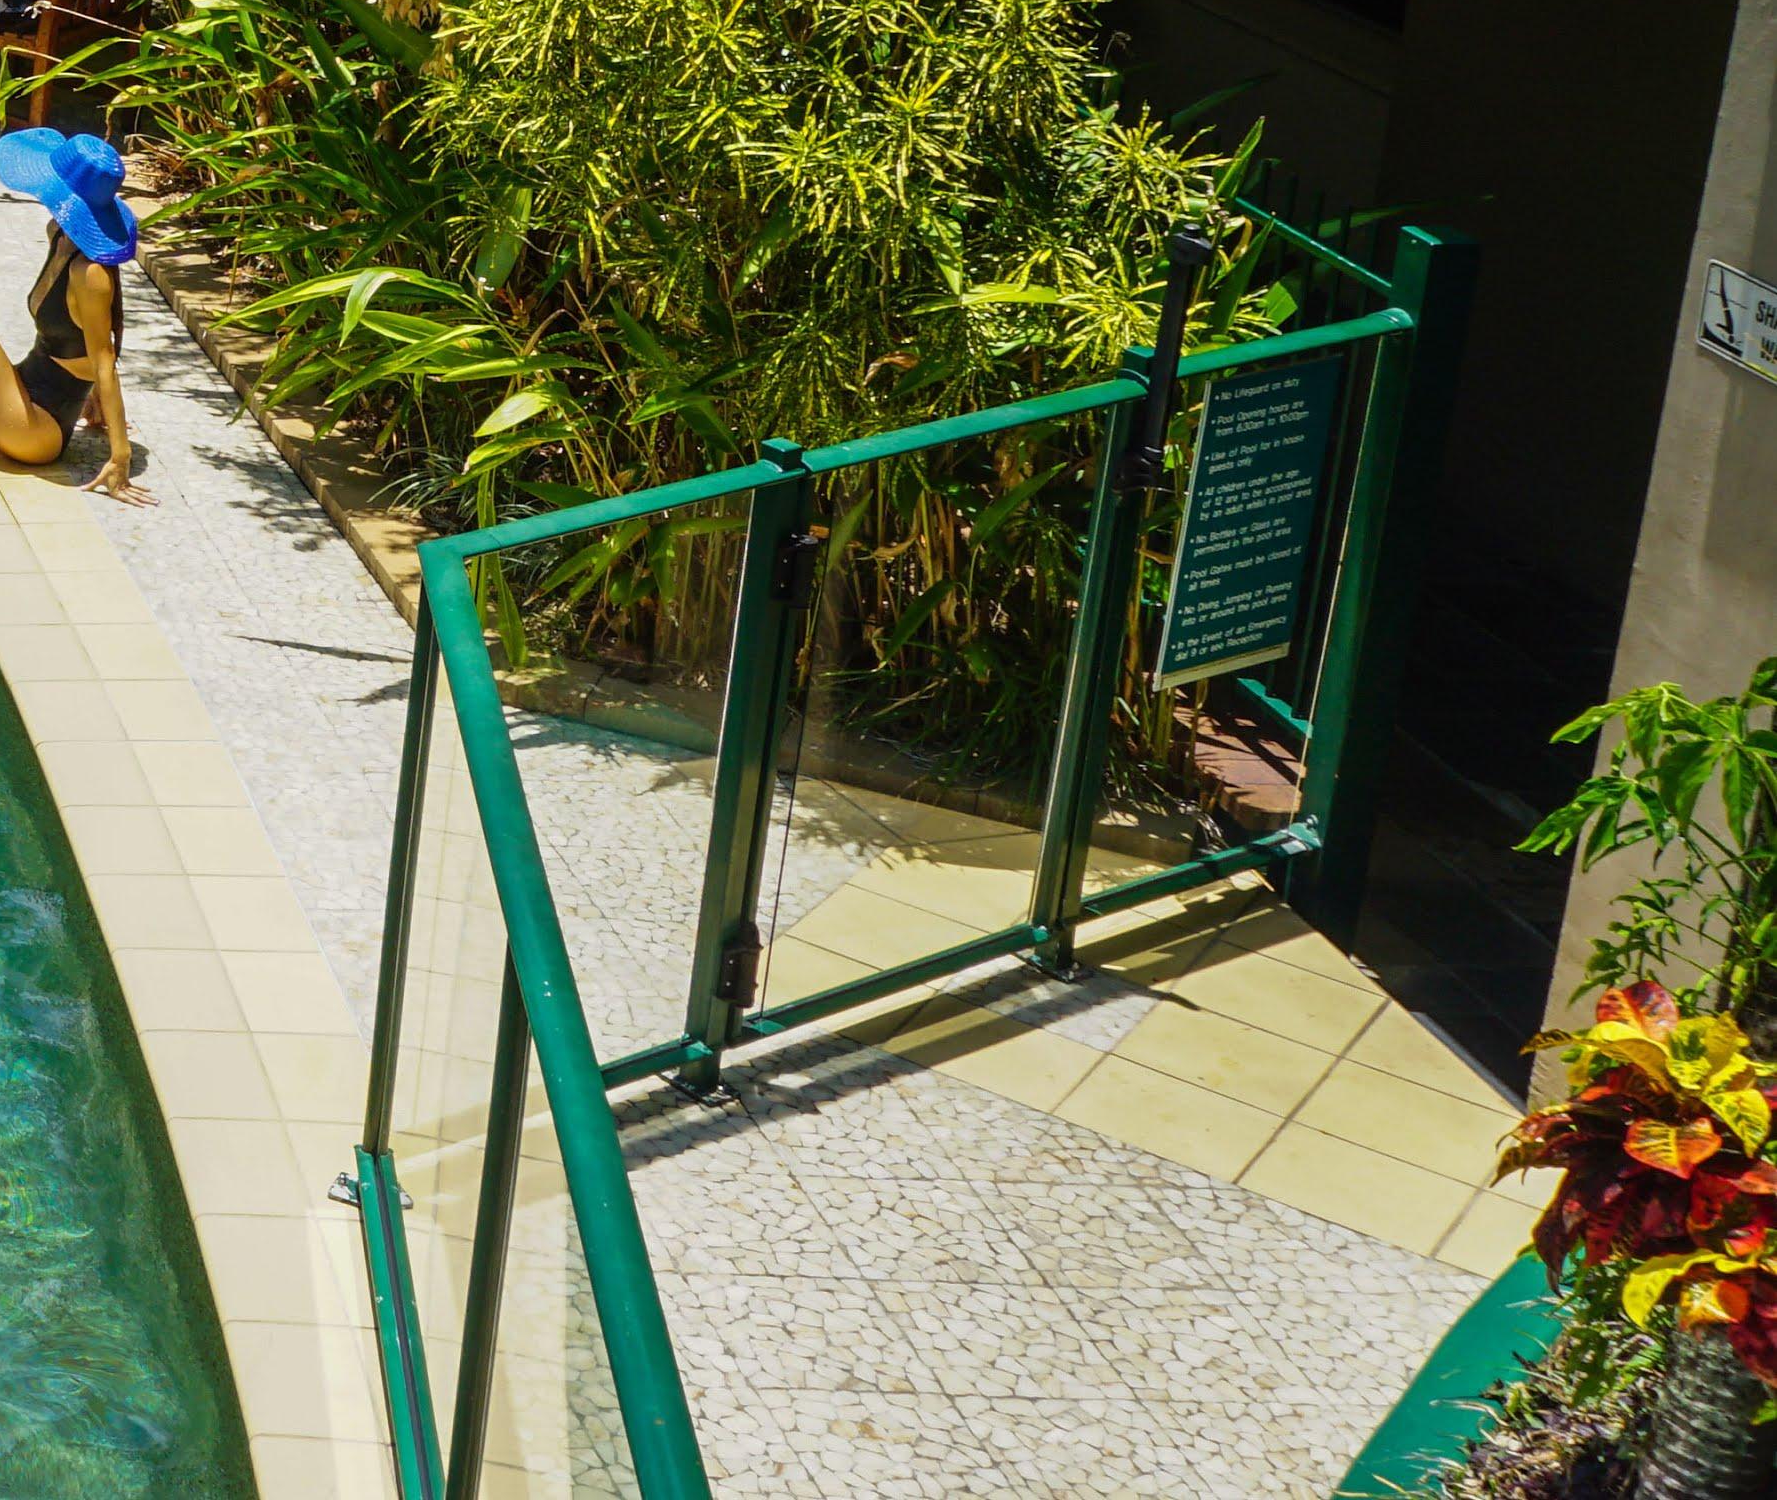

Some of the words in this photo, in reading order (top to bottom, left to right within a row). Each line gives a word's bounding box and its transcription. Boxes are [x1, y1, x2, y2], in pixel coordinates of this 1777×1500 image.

[1756, 300, 1777, 329] SH
[1221, 392, 1232, 400] No
[1235, 384, 1269, 398] Lifeguard
[1283, 379, 1300, 387] duty
[1217, 414, 1234, 424] Pool
[1237, 408, 1266, 420] Opening
[1269, 403, 1289, 412] hours
[1216, 427, 1233, 436] from
[1268, 417, 1275, 426] to
[1229, 448, 1237, 457] of
[1241, 444, 1257, 454] Pool
[1261, 441, 1271, 450] for
[1283, 434, 1304, 444] house
[1209, 461, 1234, 474] guests
[1237, 456, 1252, 466] only
[1205, 486, 1215, 496] All
[1217, 482, 1245, 494] children
[1248, 477, 1269, 486] under
[1271, 473, 1283, 481] the
[1285, 470, 1299, 479] age
[1199, 512, 1210, 521] by
[1213, 510, 1223, 518] an
[1225, 504, 1244, 515] adult
[1277, 493, 1293, 503] pool
[1296, 489, 1311, 498] area
[1202, 500, 1212, 508] of
[1225, 495, 1238, 503] are
[1242, 492, 1250, 500] to
[1253, 489, 1262, 497] be
[1194, 541, 1230, 557] permitted
[1242, 536, 1254, 544] the
[1256, 532, 1272, 542] pool
[1275, 528, 1291, 536] area
[1196, 535, 1207, 543] No
[1239, 526, 1248, 534] or
[1251, 521, 1270, 531] Glass
[1273, 518, 1286, 526] are
[1190, 568, 1207, 580] Pool
[1210, 564, 1233, 574] Gates
[1235, 558, 1253, 568] must
[1255, 556, 1265, 564] be
[1268, 548, 1291, 560] closed
[1293, 546, 1301, 554] at
[1189, 582, 1197, 591] all
[1201, 578, 1221, 588] times
[1182, 617, 1196, 626] into
[1210, 607, 1235, 619] around
[1238, 604, 1249, 612] the
[1251, 598, 1268, 610] pool
[1271, 594, 1287, 604] area
[1184, 606, 1195, 615] No
[1255, 589, 1263, 597] or
[1177, 641, 1185, 649] In
[1187, 638, 1199, 647] the
[1202, 632, 1223, 643] Event
[1225, 628, 1234, 637] of
[1236, 626, 1245, 634] an
[1248, 616, 1287, 631] Emergency
[1199, 646, 1207, 654] or
[1227, 633, 1263, 646] Reception
